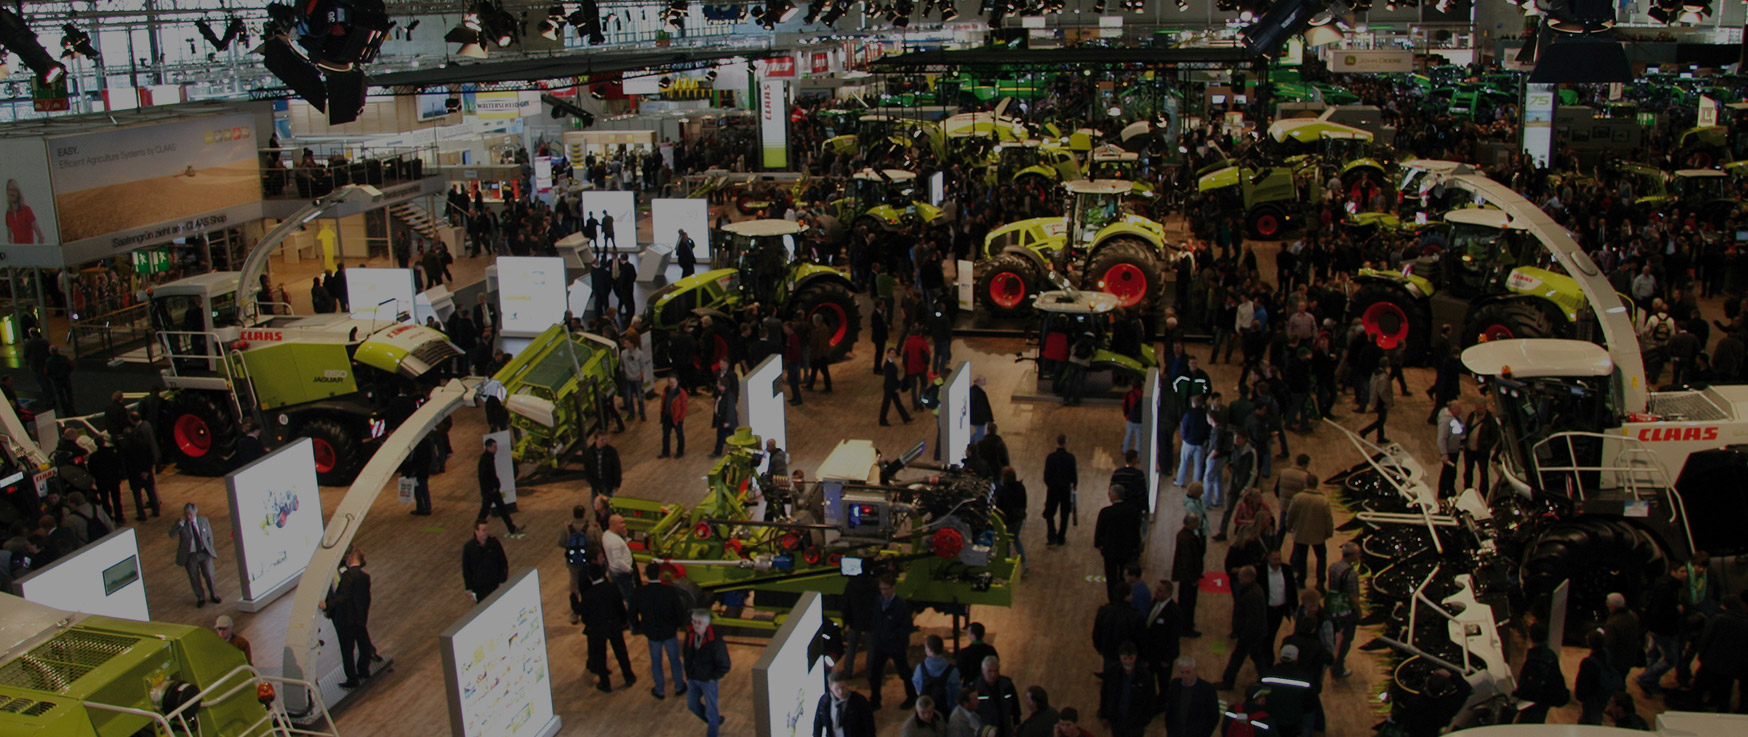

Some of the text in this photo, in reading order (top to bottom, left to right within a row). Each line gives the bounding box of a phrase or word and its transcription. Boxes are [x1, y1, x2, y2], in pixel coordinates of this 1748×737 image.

[764, 84, 772, 121] CLAAS
[1529, 95, 1550, 106] 75
[57, 146, 80, 157] EASY.
[59, 143, 176, 169] Efficient Agriculture Systems by CLAAS
[112, 230, 154, 248] Saatengrün
[155, 226, 171, 238] zieht
[210, 213, 227, 226] Shop
[1513, 273, 1533, 284] CLAAS
[240, 331, 283, 341] CLAAS
[313, 376, 344, 384] JAGUAR
[1638, 427, 1719, 442] CLAAS
[36, 469, 57, 482] CLAAS
